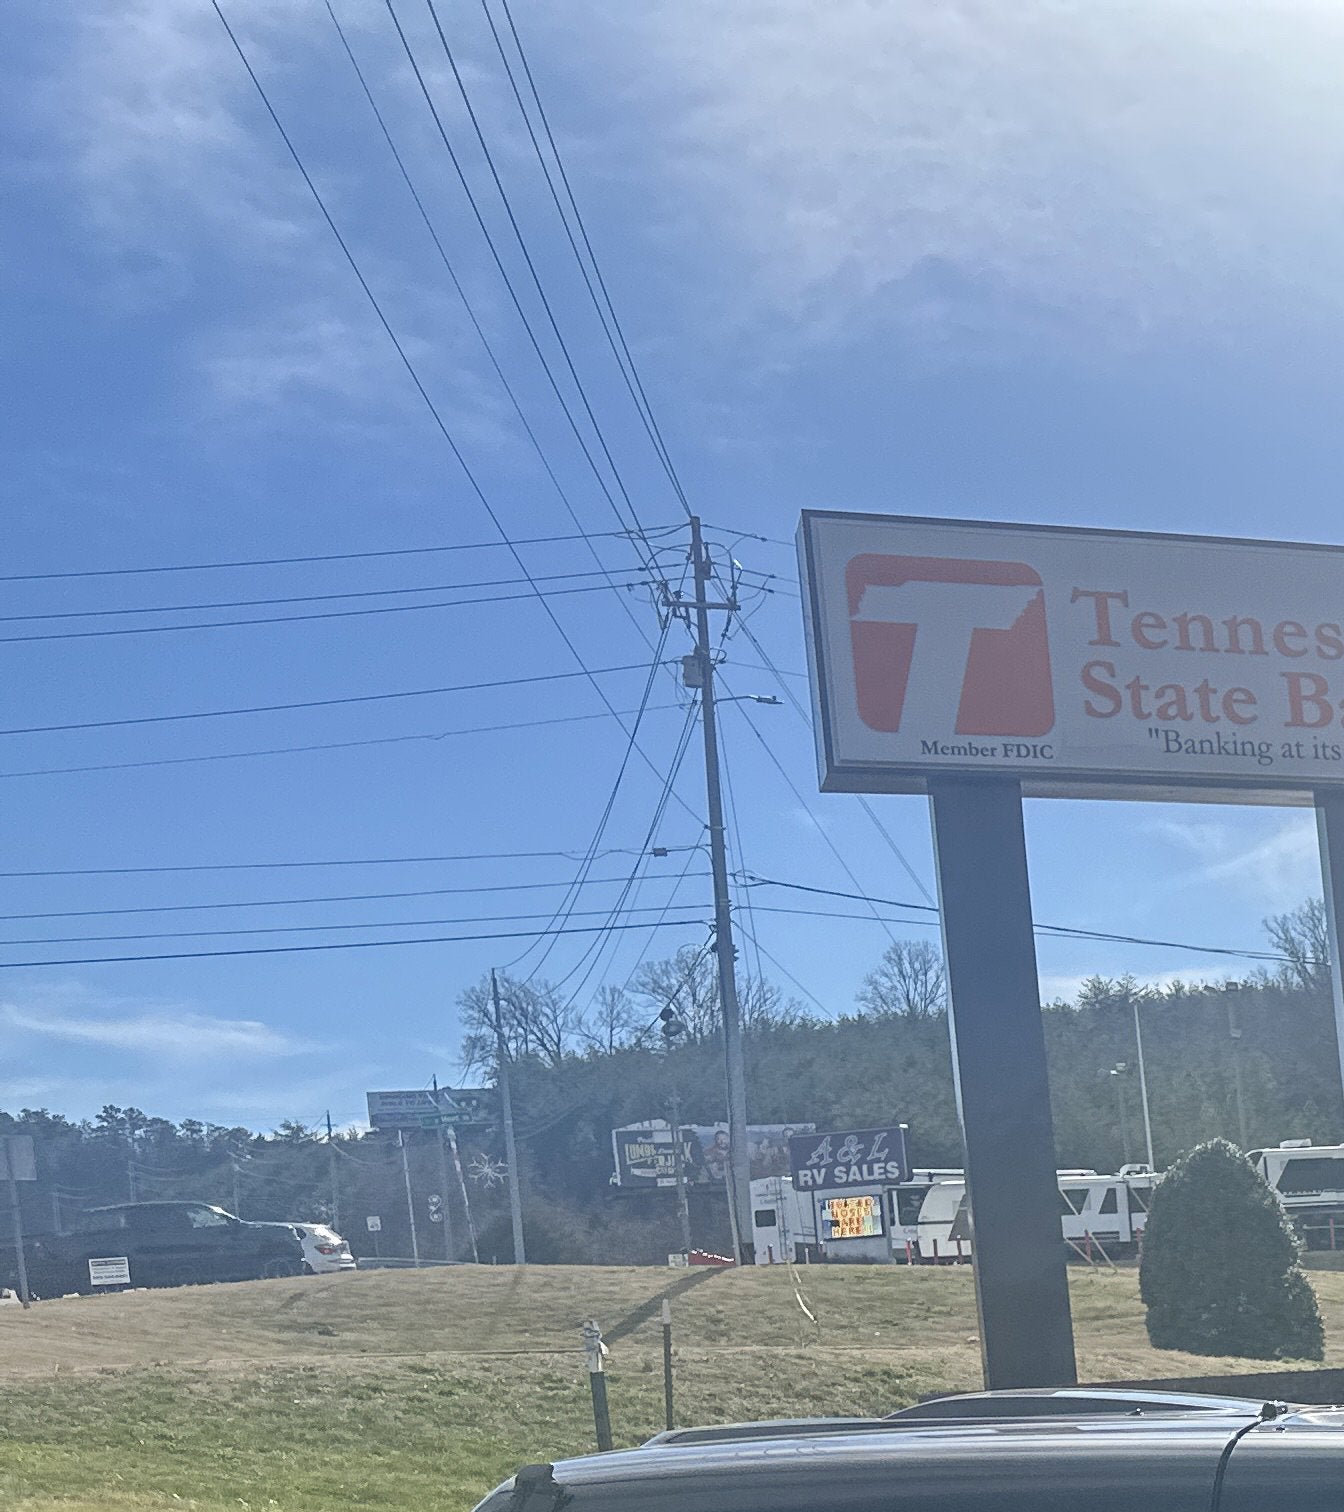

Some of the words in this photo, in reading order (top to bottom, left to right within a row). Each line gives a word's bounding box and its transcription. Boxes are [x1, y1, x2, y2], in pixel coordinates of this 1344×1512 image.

[1081, 660, 1260, 723] State
[920, 740, 999, 757] Member
[1002, 743, 1053, 760] FDIC
[1148, 727, 1273, 766] "Banking
[1281, 741, 1304, 760] at
[1313, 736, 1342, 761] its
[806, 1136, 833, 1166] A
[837, 1135, 864, 1165] &
[867, 1132, 889, 1160] L
[798, 1168, 826, 1186] RV
[834, 1161, 900, 1183] SALES
